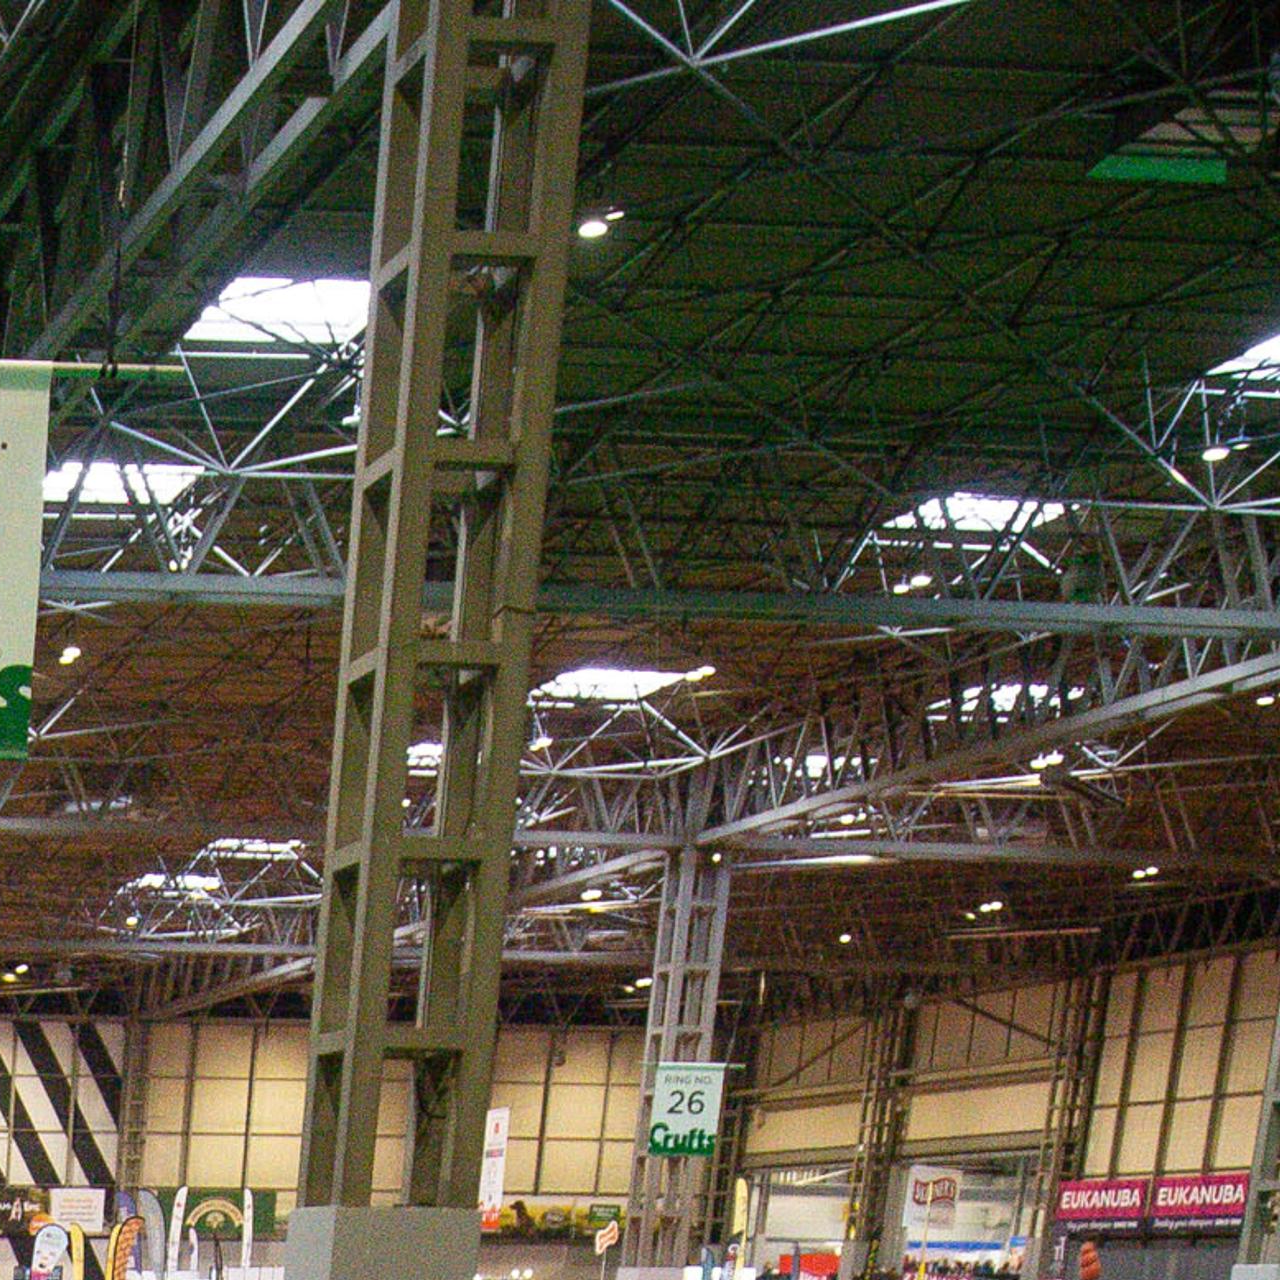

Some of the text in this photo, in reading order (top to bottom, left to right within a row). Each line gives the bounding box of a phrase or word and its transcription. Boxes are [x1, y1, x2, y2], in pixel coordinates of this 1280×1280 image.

[664, 1073, 696, 1085] RING
[666, 1090, 706, 1116] 26
[649, 1122, 717, 1151] Crufts
[1061, 1188, 1140, 1210] EUKANUBA
[1156, 1184, 1245, 1207] EUKANUBA
